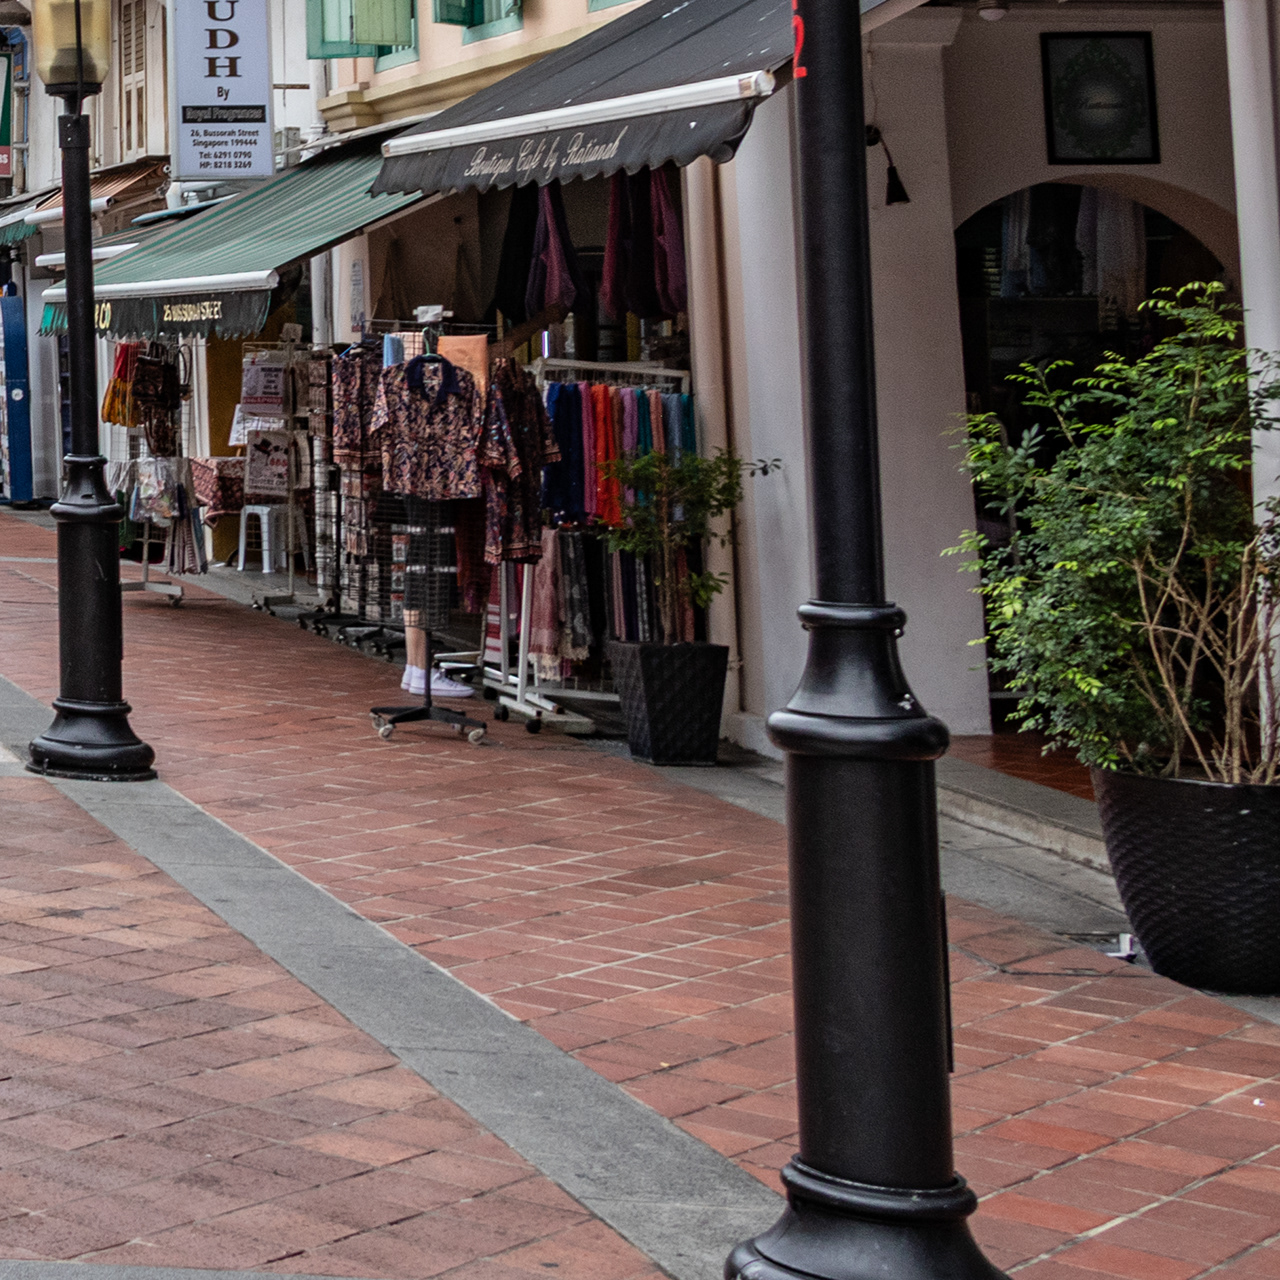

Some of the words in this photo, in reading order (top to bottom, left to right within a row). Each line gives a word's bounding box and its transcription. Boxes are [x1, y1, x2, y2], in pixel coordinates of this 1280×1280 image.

[217, 86, 230, 101] By
[238, 129, 259, 137] Street
[192, 139, 228, 148] Singapore
[543, 136, 561, 180] by
